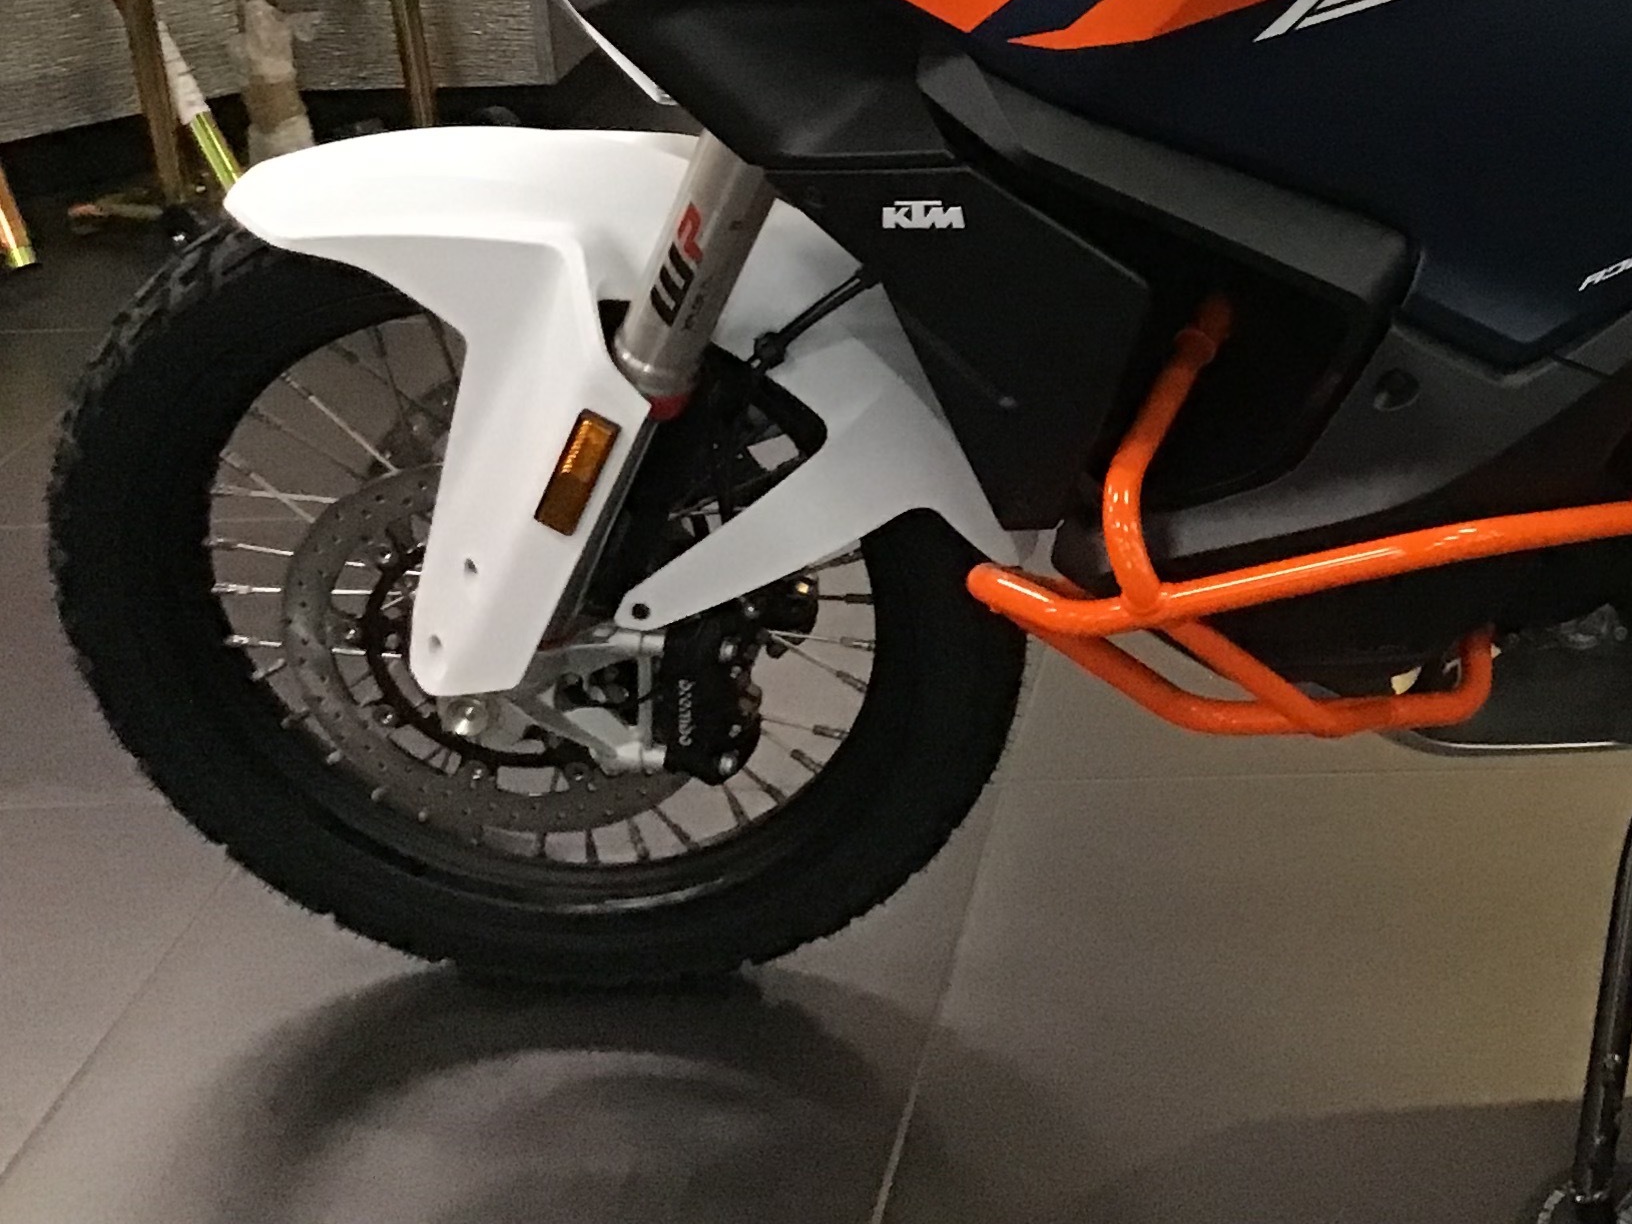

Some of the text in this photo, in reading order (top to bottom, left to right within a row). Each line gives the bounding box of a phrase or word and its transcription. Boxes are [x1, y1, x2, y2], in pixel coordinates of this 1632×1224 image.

[882, 200, 965, 229] KTM
[650, 201, 703, 327] WP
[678, 679, 696, 746] brembo
